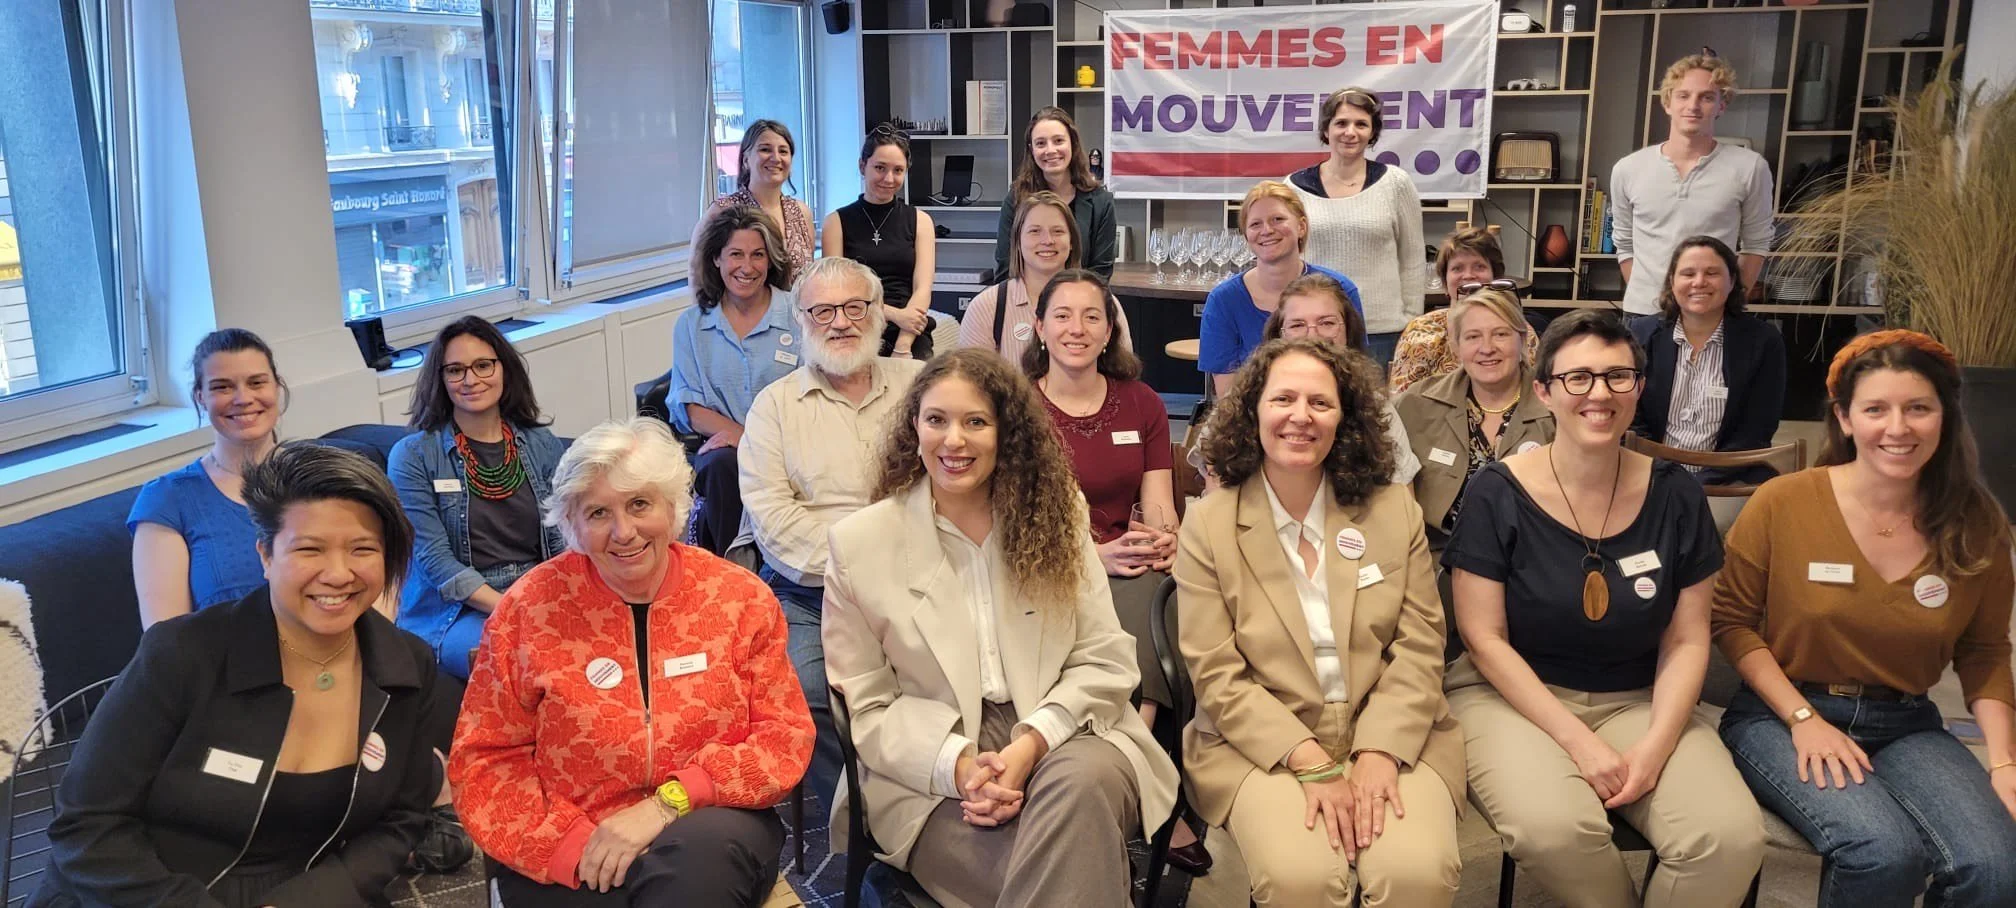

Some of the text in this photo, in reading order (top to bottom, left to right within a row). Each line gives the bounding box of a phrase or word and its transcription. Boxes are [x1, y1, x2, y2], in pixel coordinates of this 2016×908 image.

[1111, 23, 1445, 70] FEMMES EN
[1111, 88, 1487, 133] MOUVEENT
[330, 194, 379, 212] aubourg
[381, 190, 409, 207] Saint
